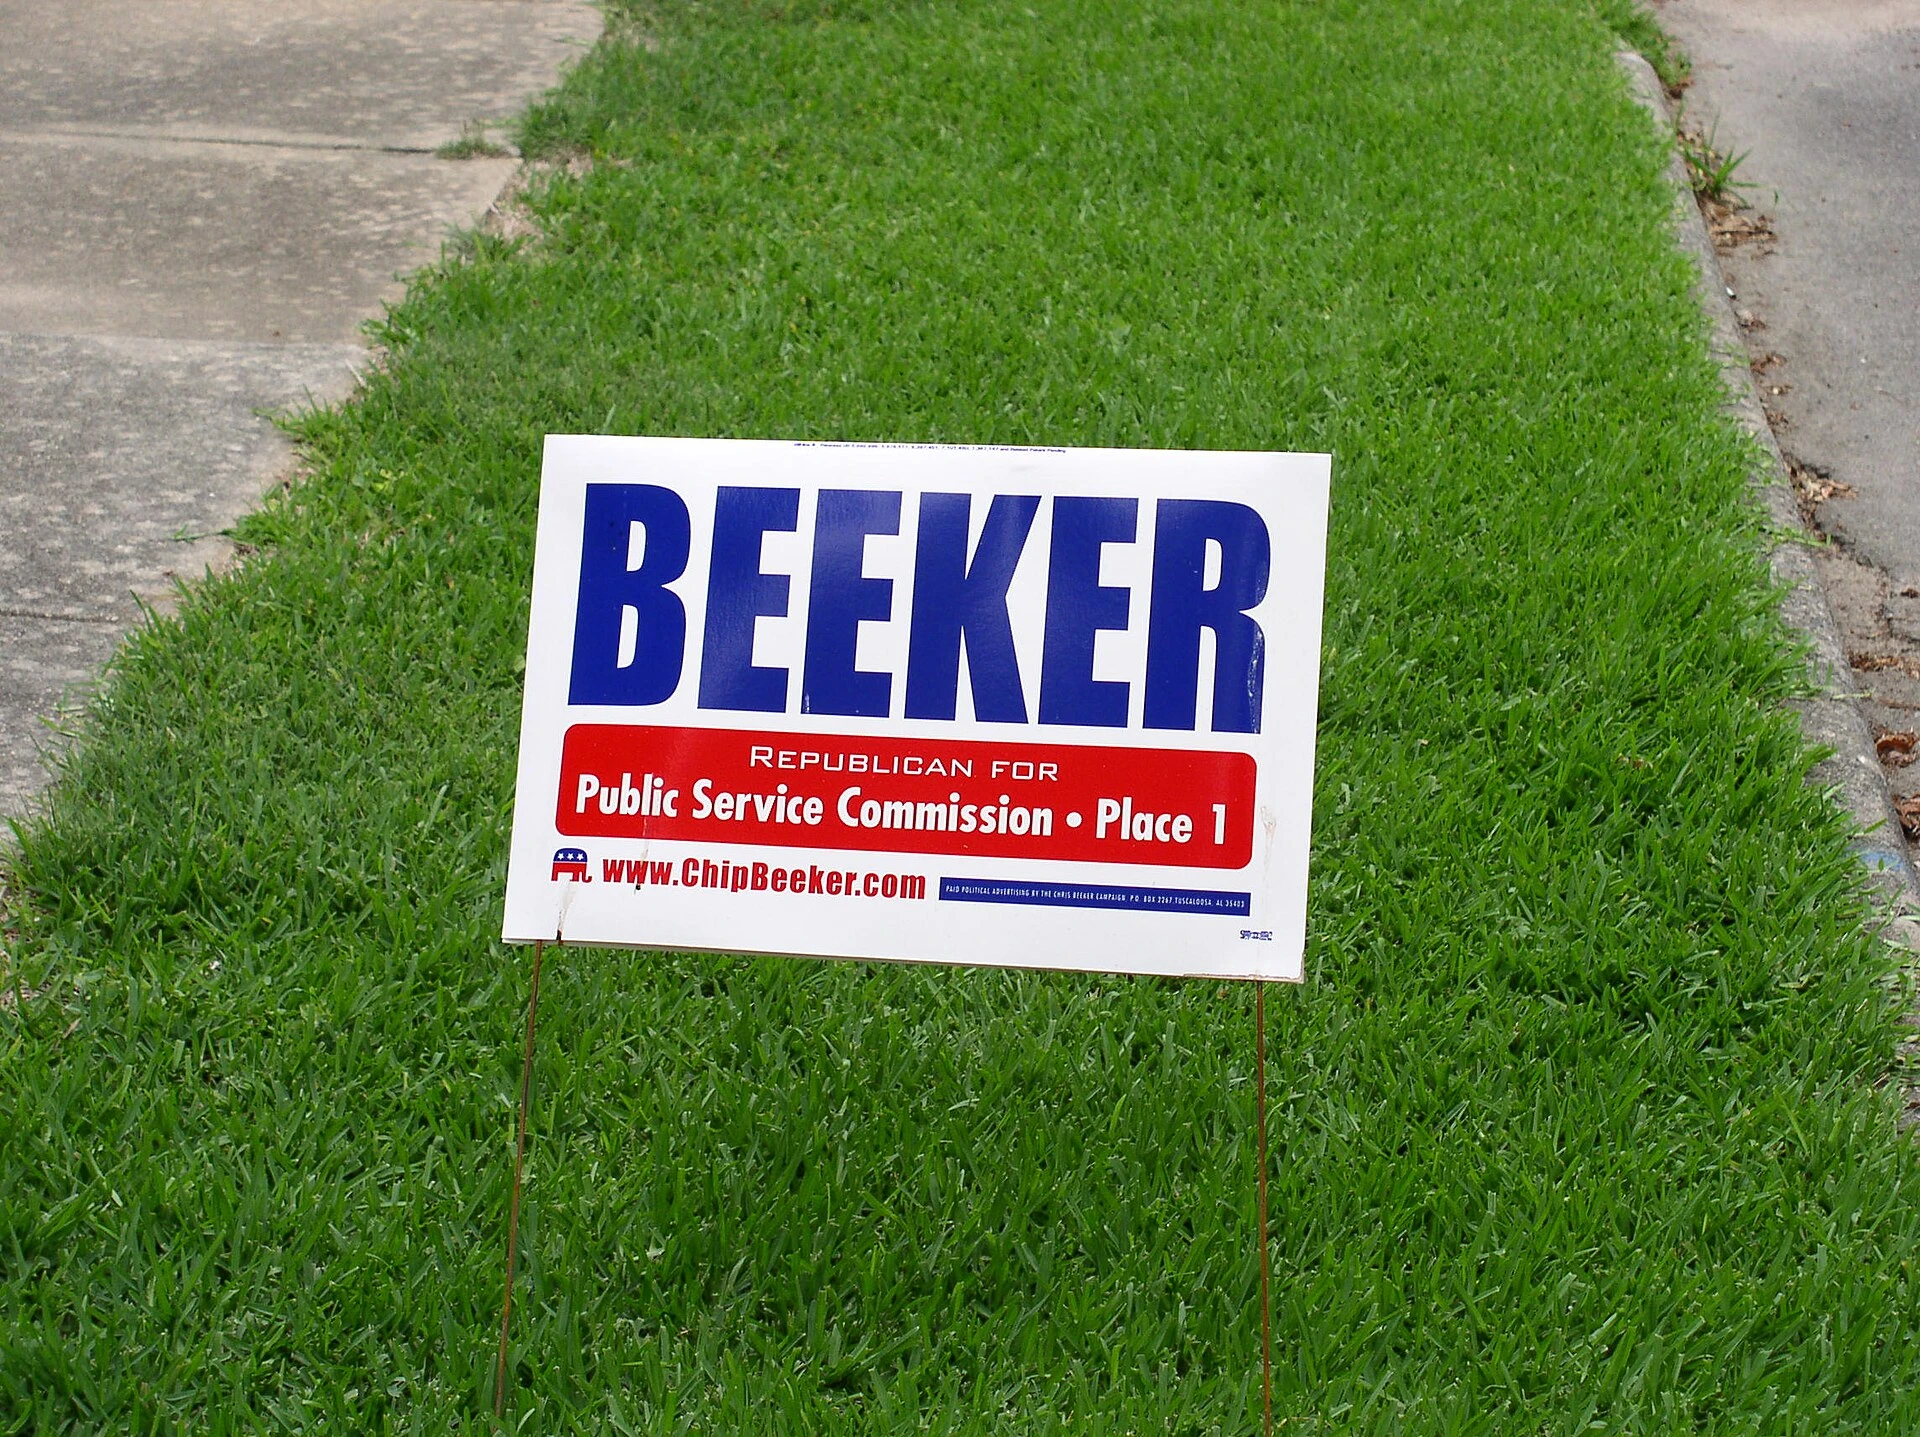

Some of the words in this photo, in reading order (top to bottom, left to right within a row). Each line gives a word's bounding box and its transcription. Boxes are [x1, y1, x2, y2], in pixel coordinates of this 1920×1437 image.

[568, 483, 1271, 734] BEEKER
[750, 745, 973, 778] REPUBLICAN
[991, 760, 1059, 782] FOR
[575, 772, 679, 818] Public
[692, 778, 824, 826] Service
[837, 786, 1053, 837] Commission
[1096, 796, 1194, 844] Place
[1212, 803, 1227, 845] 1
[602, 857, 926, 900] www.ChipBeeker.com
[945, 885, 960, 893] PAID
[961, 886, 990, 895] POLITICAL
[992, 887, 1030, 897] ADVERTISING
[1031, 889, 1040, 897] BY
[1041, 890, 1052, 898] THE
[1073, 891, 1094, 900] BEEKER
[1143, 895, 1156, 903] BOX
